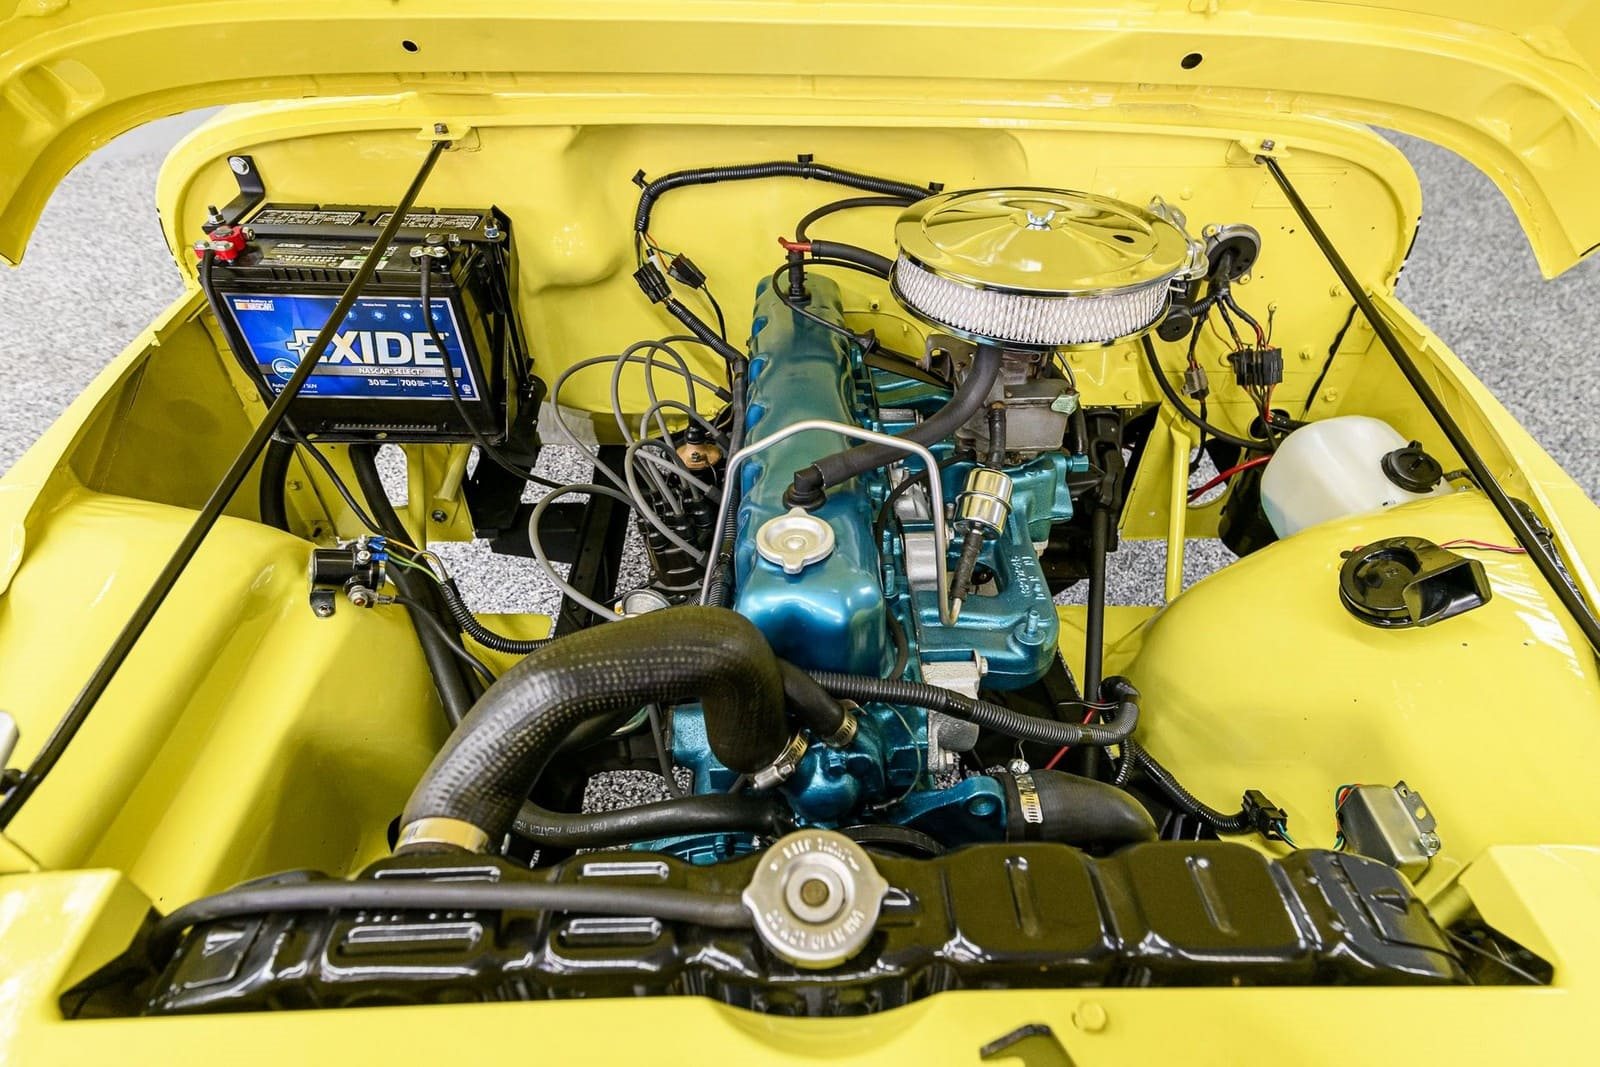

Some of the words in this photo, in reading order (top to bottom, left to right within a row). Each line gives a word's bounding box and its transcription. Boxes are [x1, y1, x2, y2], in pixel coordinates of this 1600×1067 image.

[286, 329, 445, 366] EXIDE
[367, 378, 379, 386] 30
[400, 379, 417, 387] 700
